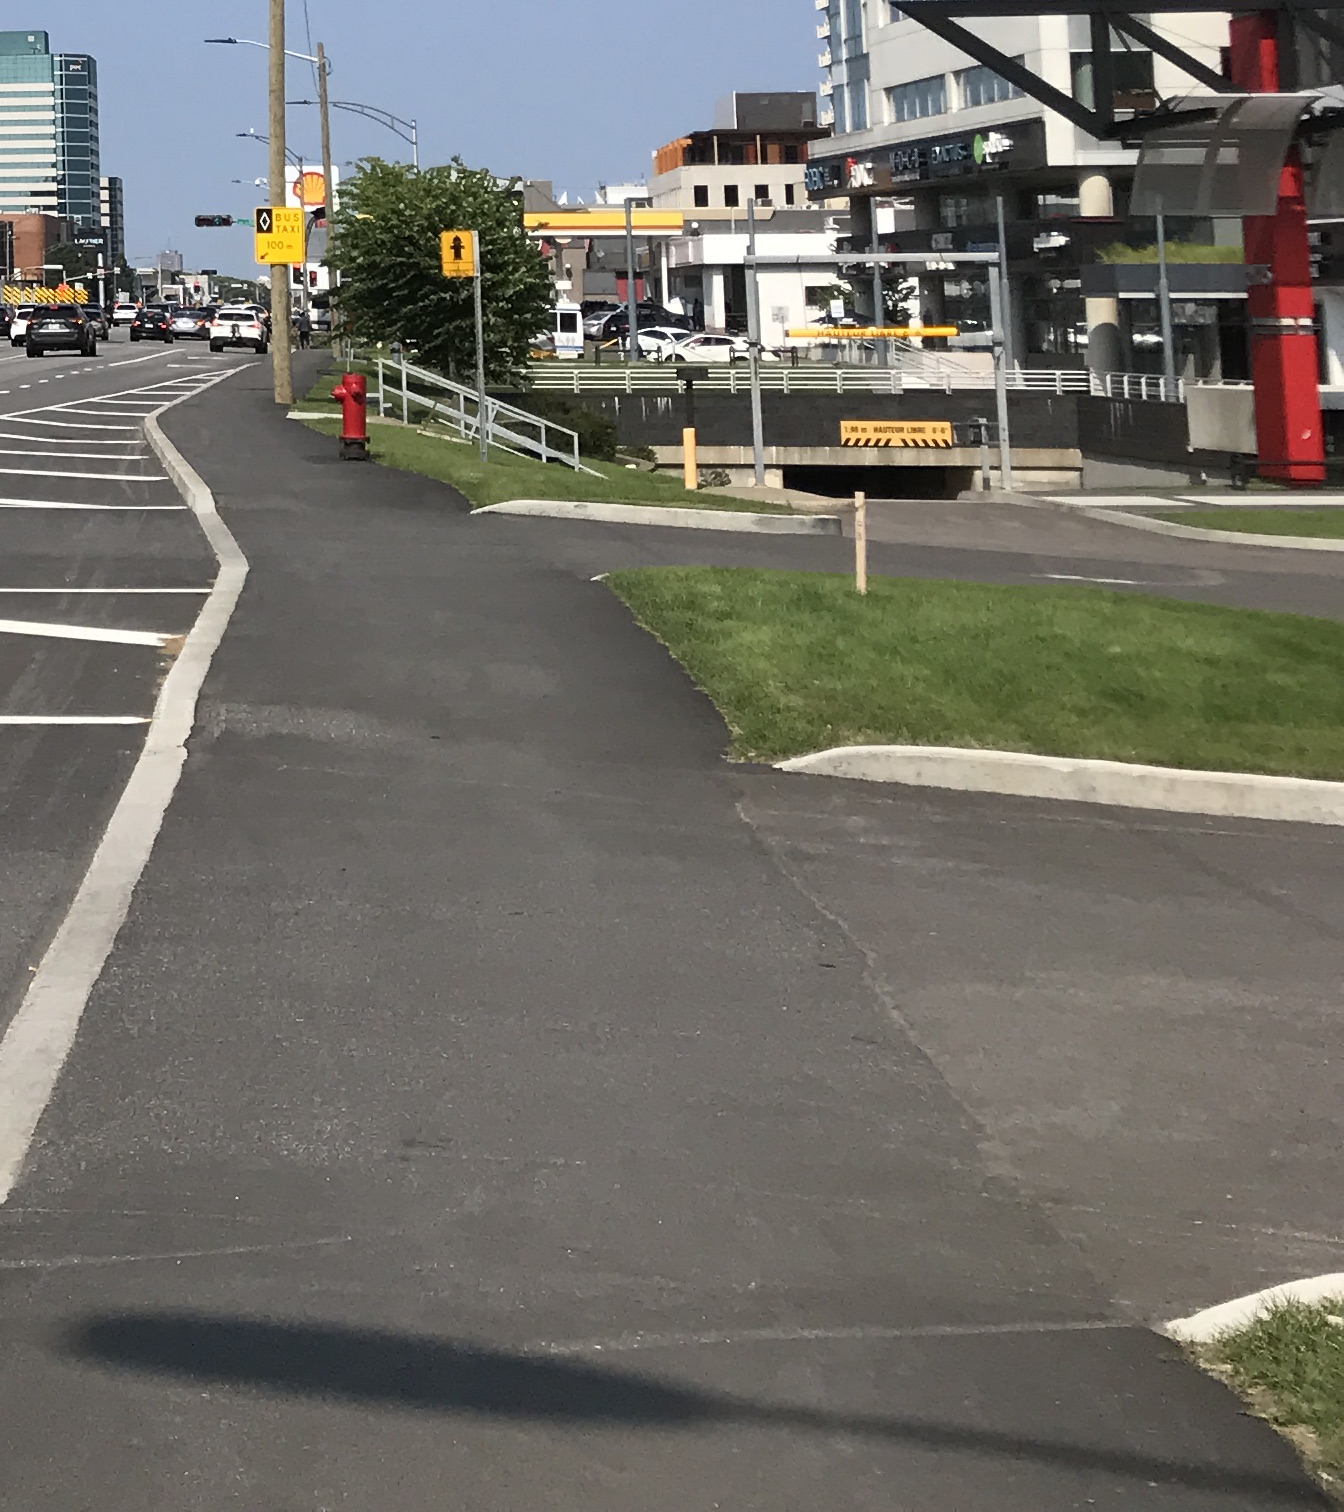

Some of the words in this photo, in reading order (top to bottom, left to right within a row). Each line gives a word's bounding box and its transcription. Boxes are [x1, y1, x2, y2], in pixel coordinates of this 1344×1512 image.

[275, 213, 300, 222] BUS
[275, 225, 300, 234] TAXI
[267, 241, 284, 250] 100
[873, 426, 905, 434] HAUTEUR
[906, 426, 926, 434] LIBRE
